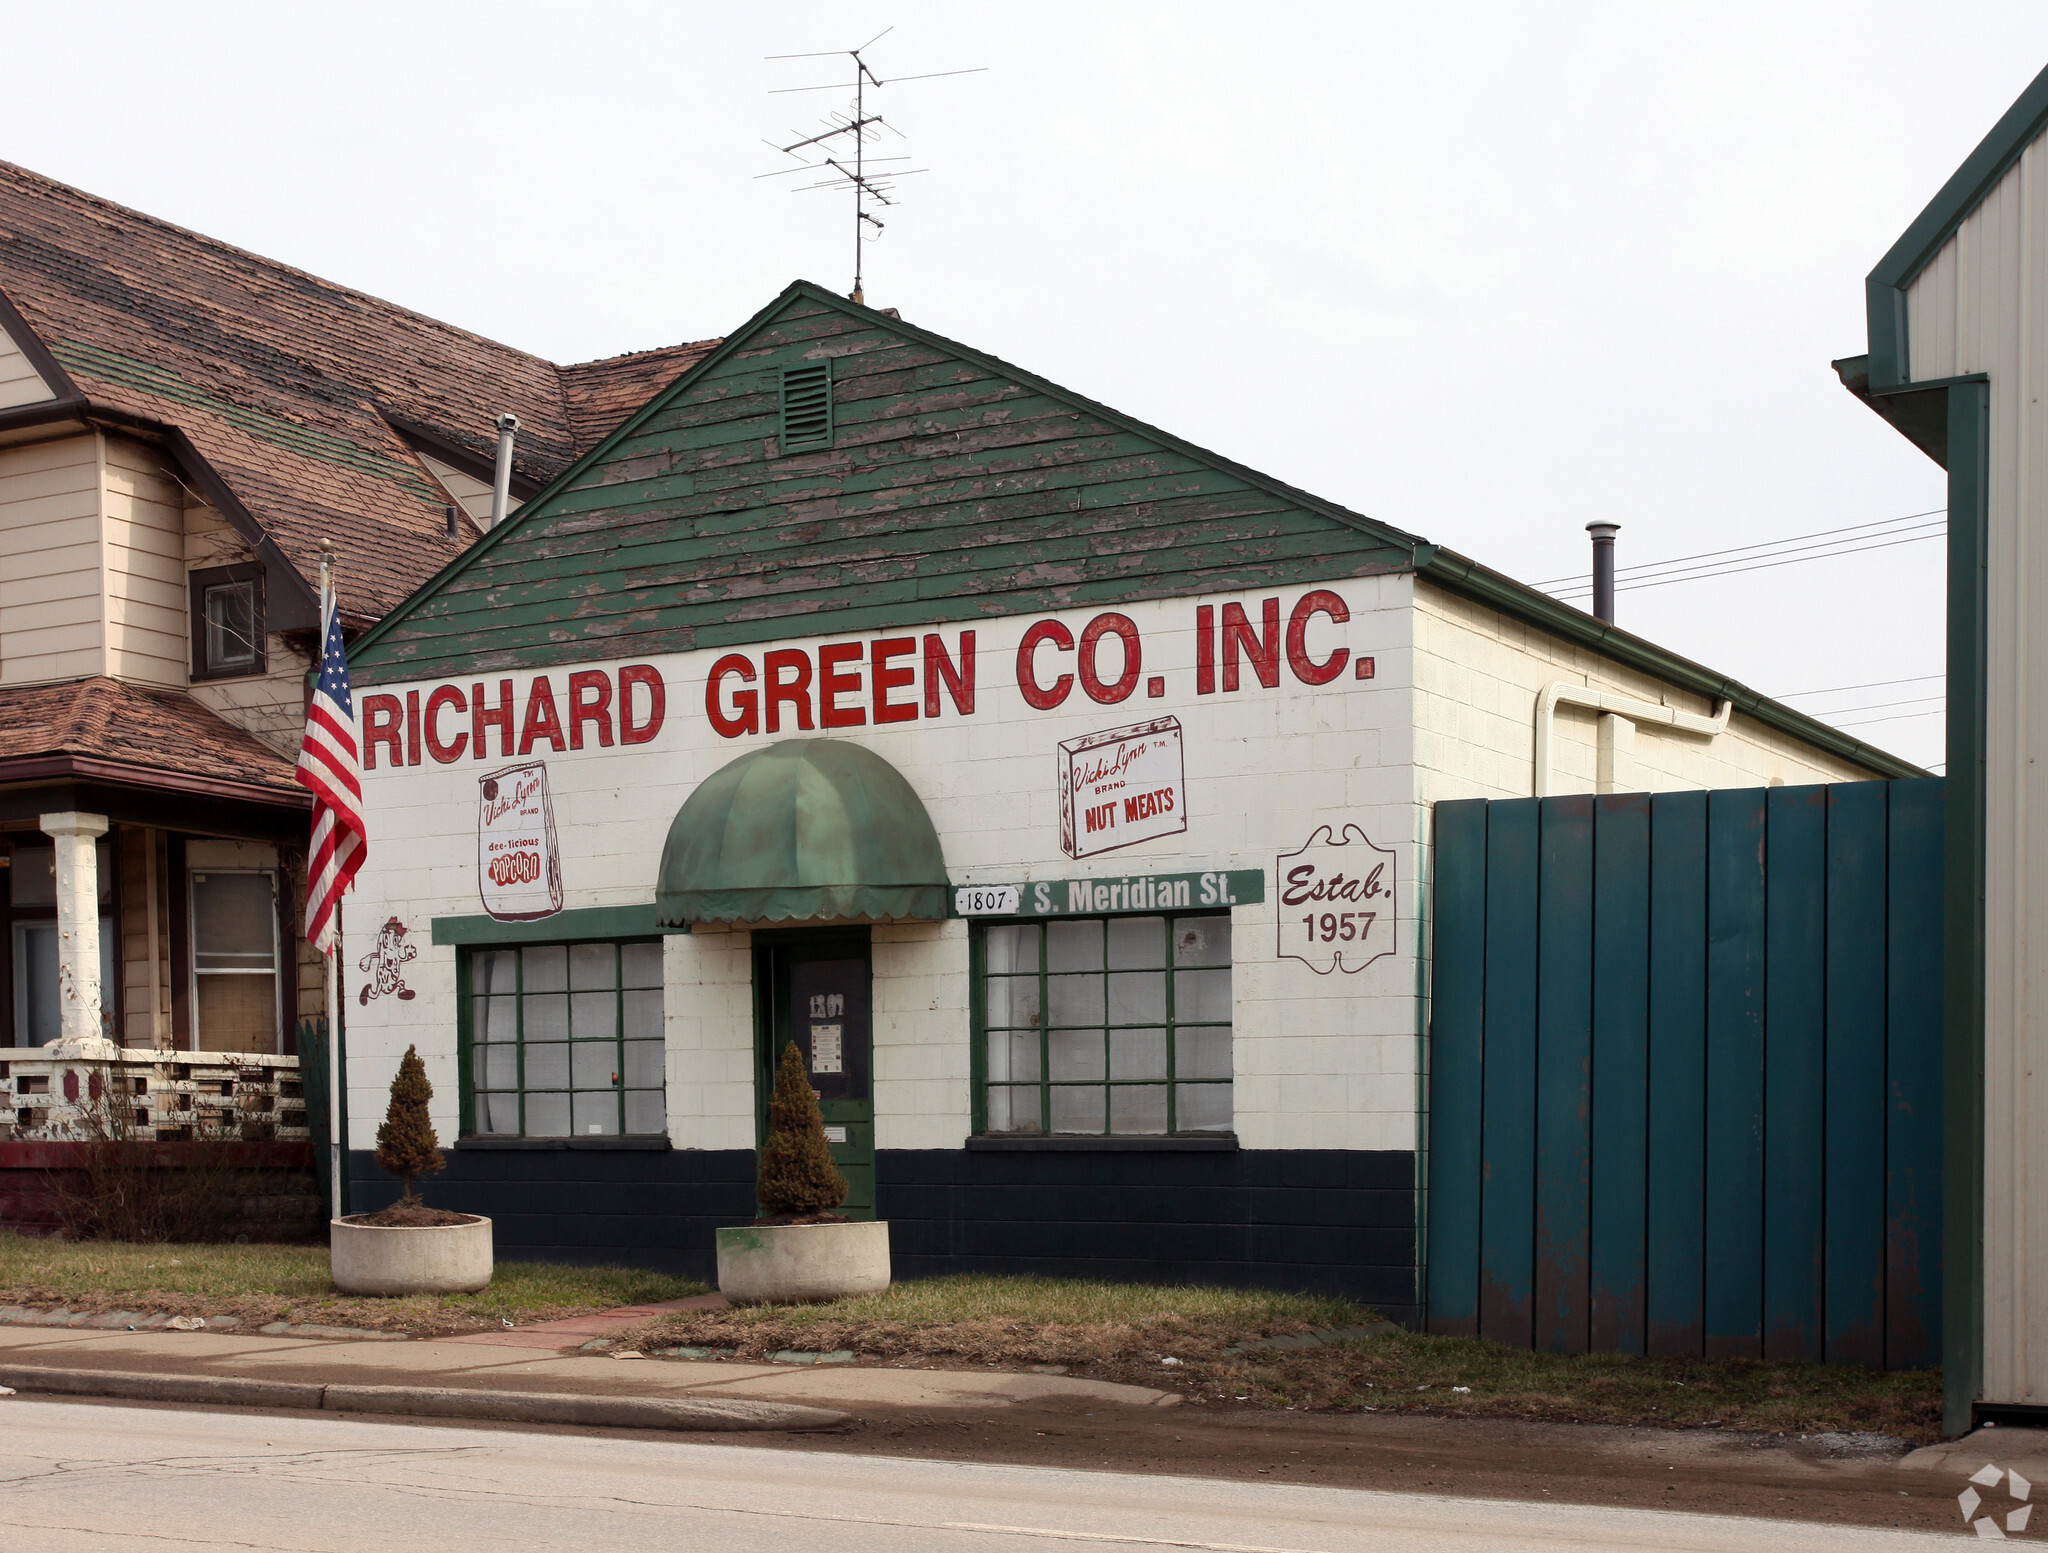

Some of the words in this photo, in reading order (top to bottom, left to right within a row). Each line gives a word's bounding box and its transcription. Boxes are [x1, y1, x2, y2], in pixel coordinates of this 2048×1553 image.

[363, 664, 665, 770] RICHARD
[705, 630, 976, 739] GREEN
[1016, 612, 1165, 711] CO.
[1196, 589, 1375, 695] INC.
[1074, 757, 1109, 793] Vicki
[1109, 743, 1147, 775] Lynn
[1094, 780, 1126, 795] BRAND
[483, 796, 511, 826] Vicki
[520, 807, 539, 816] BRAND
[1085, 801, 1117, 833] NUT
[1124, 787, 1174, 824] MEATS
[489, 838, 539, 851] dee-licious
[493, 853, 538, 882] POPCORN
[1034, 883, 1058, 914] S.
[1068, 877, 1190, 912] Meridian
[1200, 873, 1236, 905] St.
[1282, 862, 1391, 906] Estab.
[967, 891, 1006, 911] 1807
[1302, 912, 1376, 942] 1957
